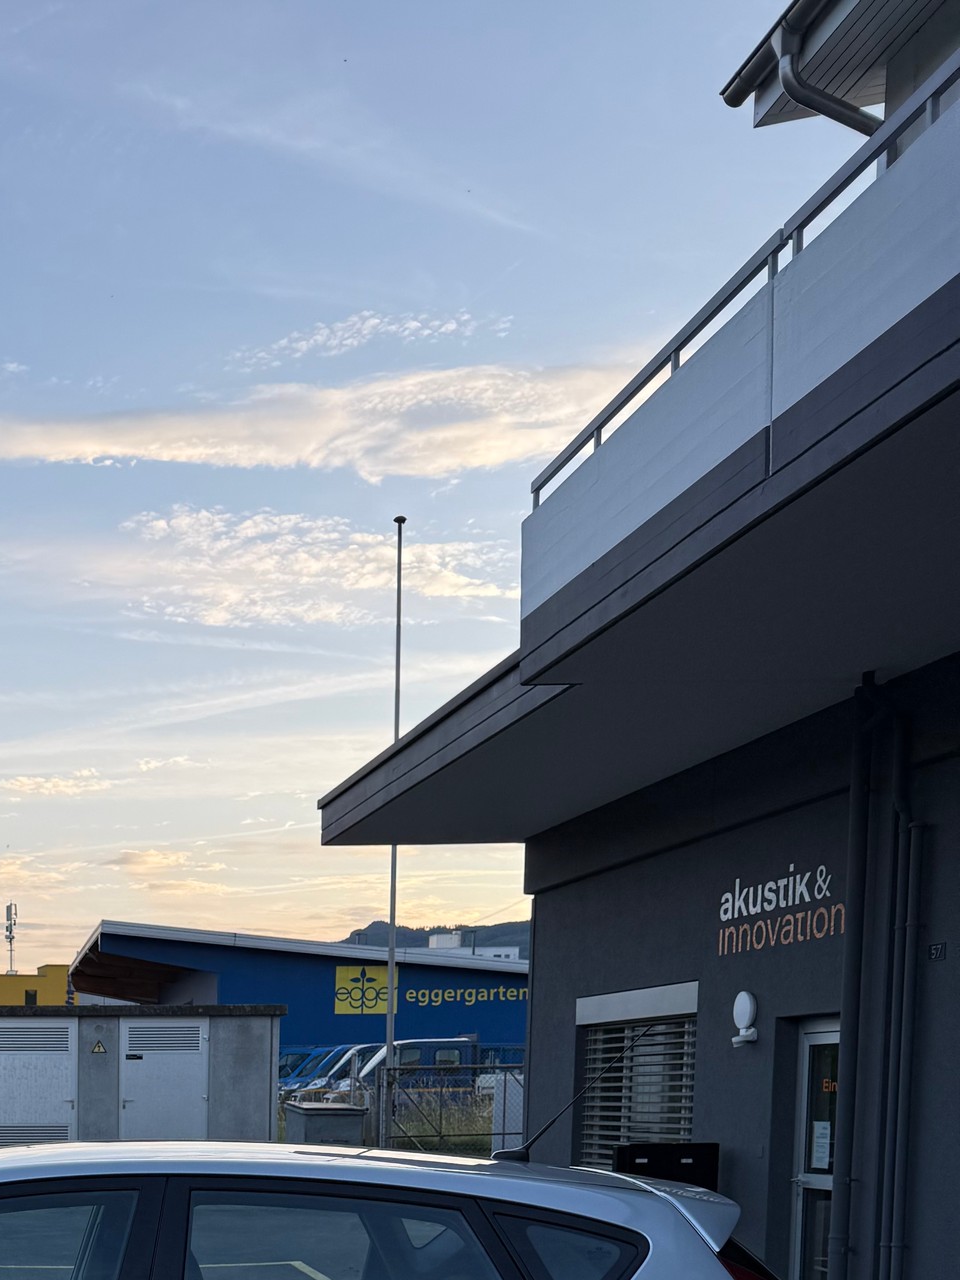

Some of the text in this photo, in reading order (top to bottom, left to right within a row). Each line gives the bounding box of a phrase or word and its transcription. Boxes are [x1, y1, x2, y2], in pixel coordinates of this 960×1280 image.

[720, 863, 812, 922] akustik
[718, 903, 846, 957] innovation
[931, 944, 942, 959] 57
[335, 986, 398, 1009] egge
[405, 985, 529, 1006] eggergarten
